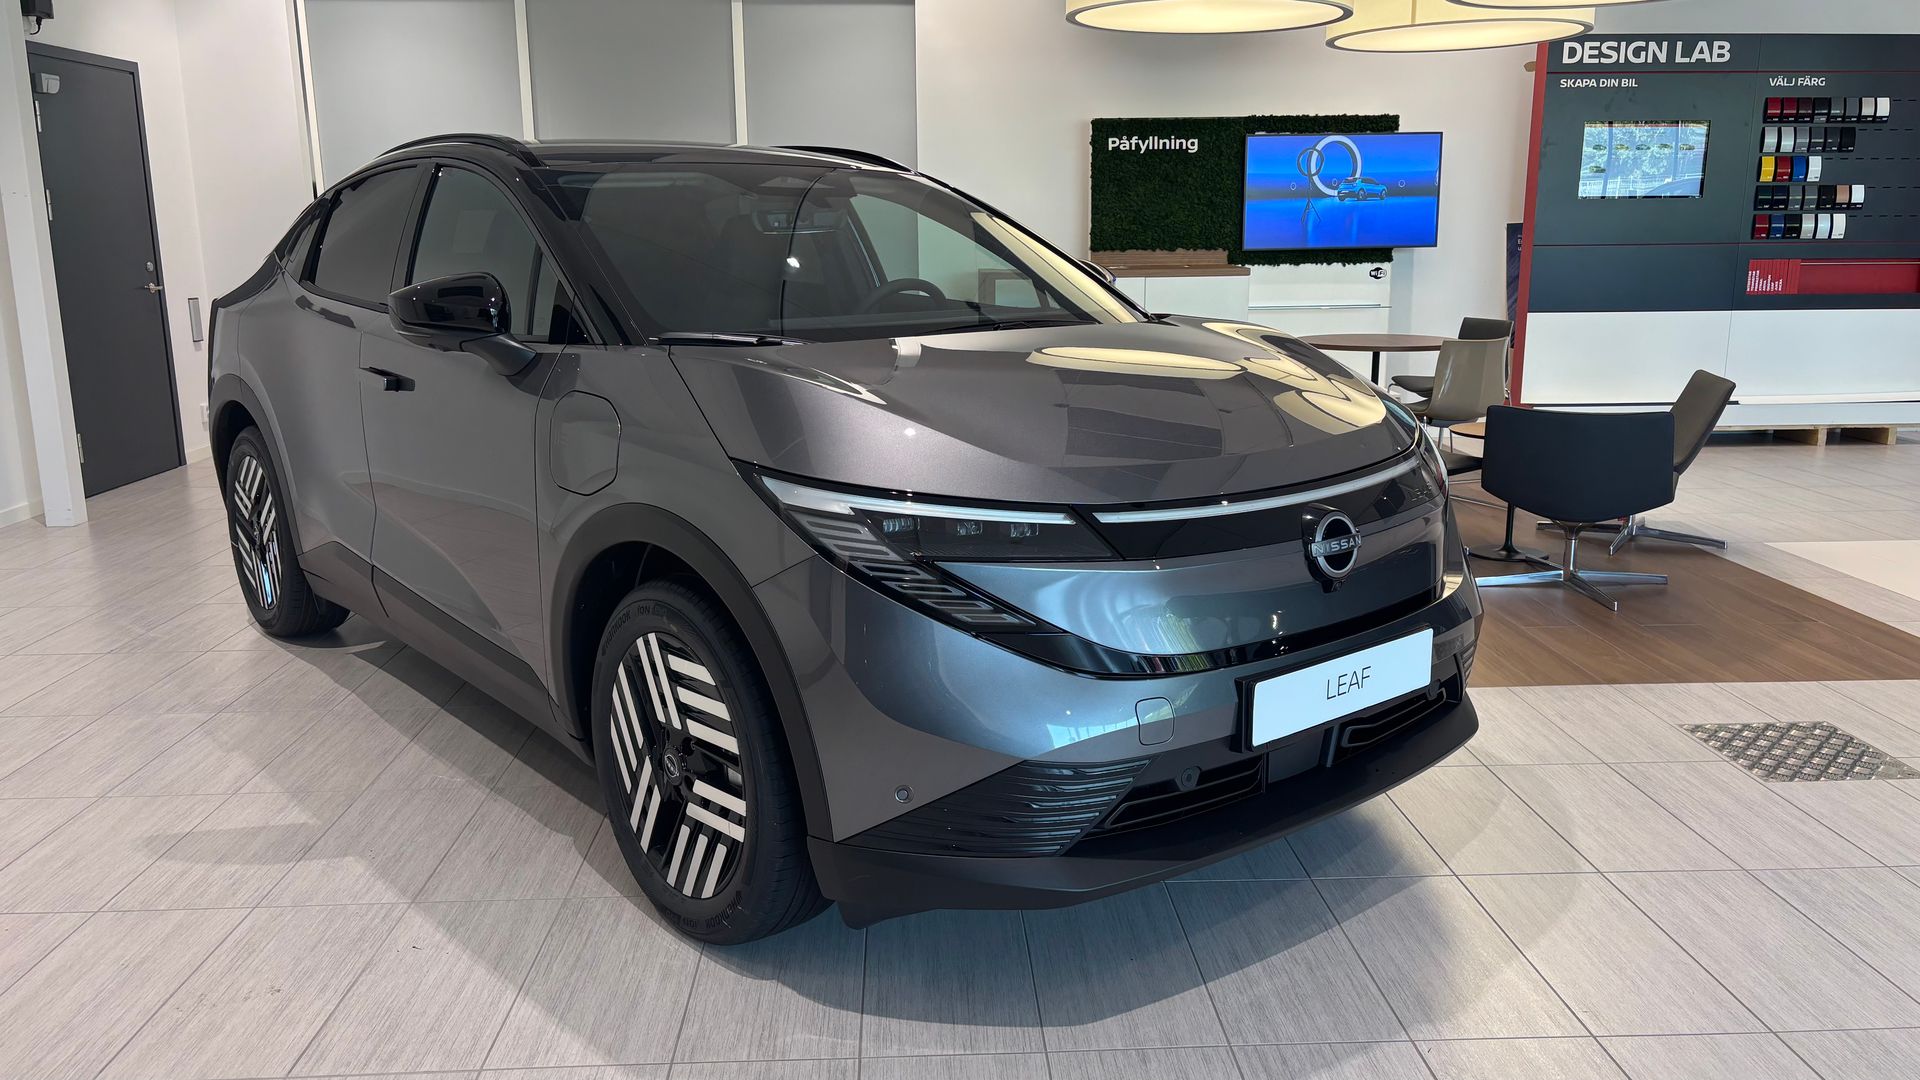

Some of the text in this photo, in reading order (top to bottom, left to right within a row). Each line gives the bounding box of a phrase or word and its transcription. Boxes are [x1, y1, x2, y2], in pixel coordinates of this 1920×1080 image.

[1562, 40, 1731, 64] DESIGN LAB
[1559, 78, 1639, 88] SKAPA DIN BIL
[1769, 75, 1826, 87] VÄLJ FÄRG
[1108, 136, 1199, 154] Påfyllning
[1314, 534, 1361, 554] NISSAN
[1326, 665, 1371, 700] LEAF
